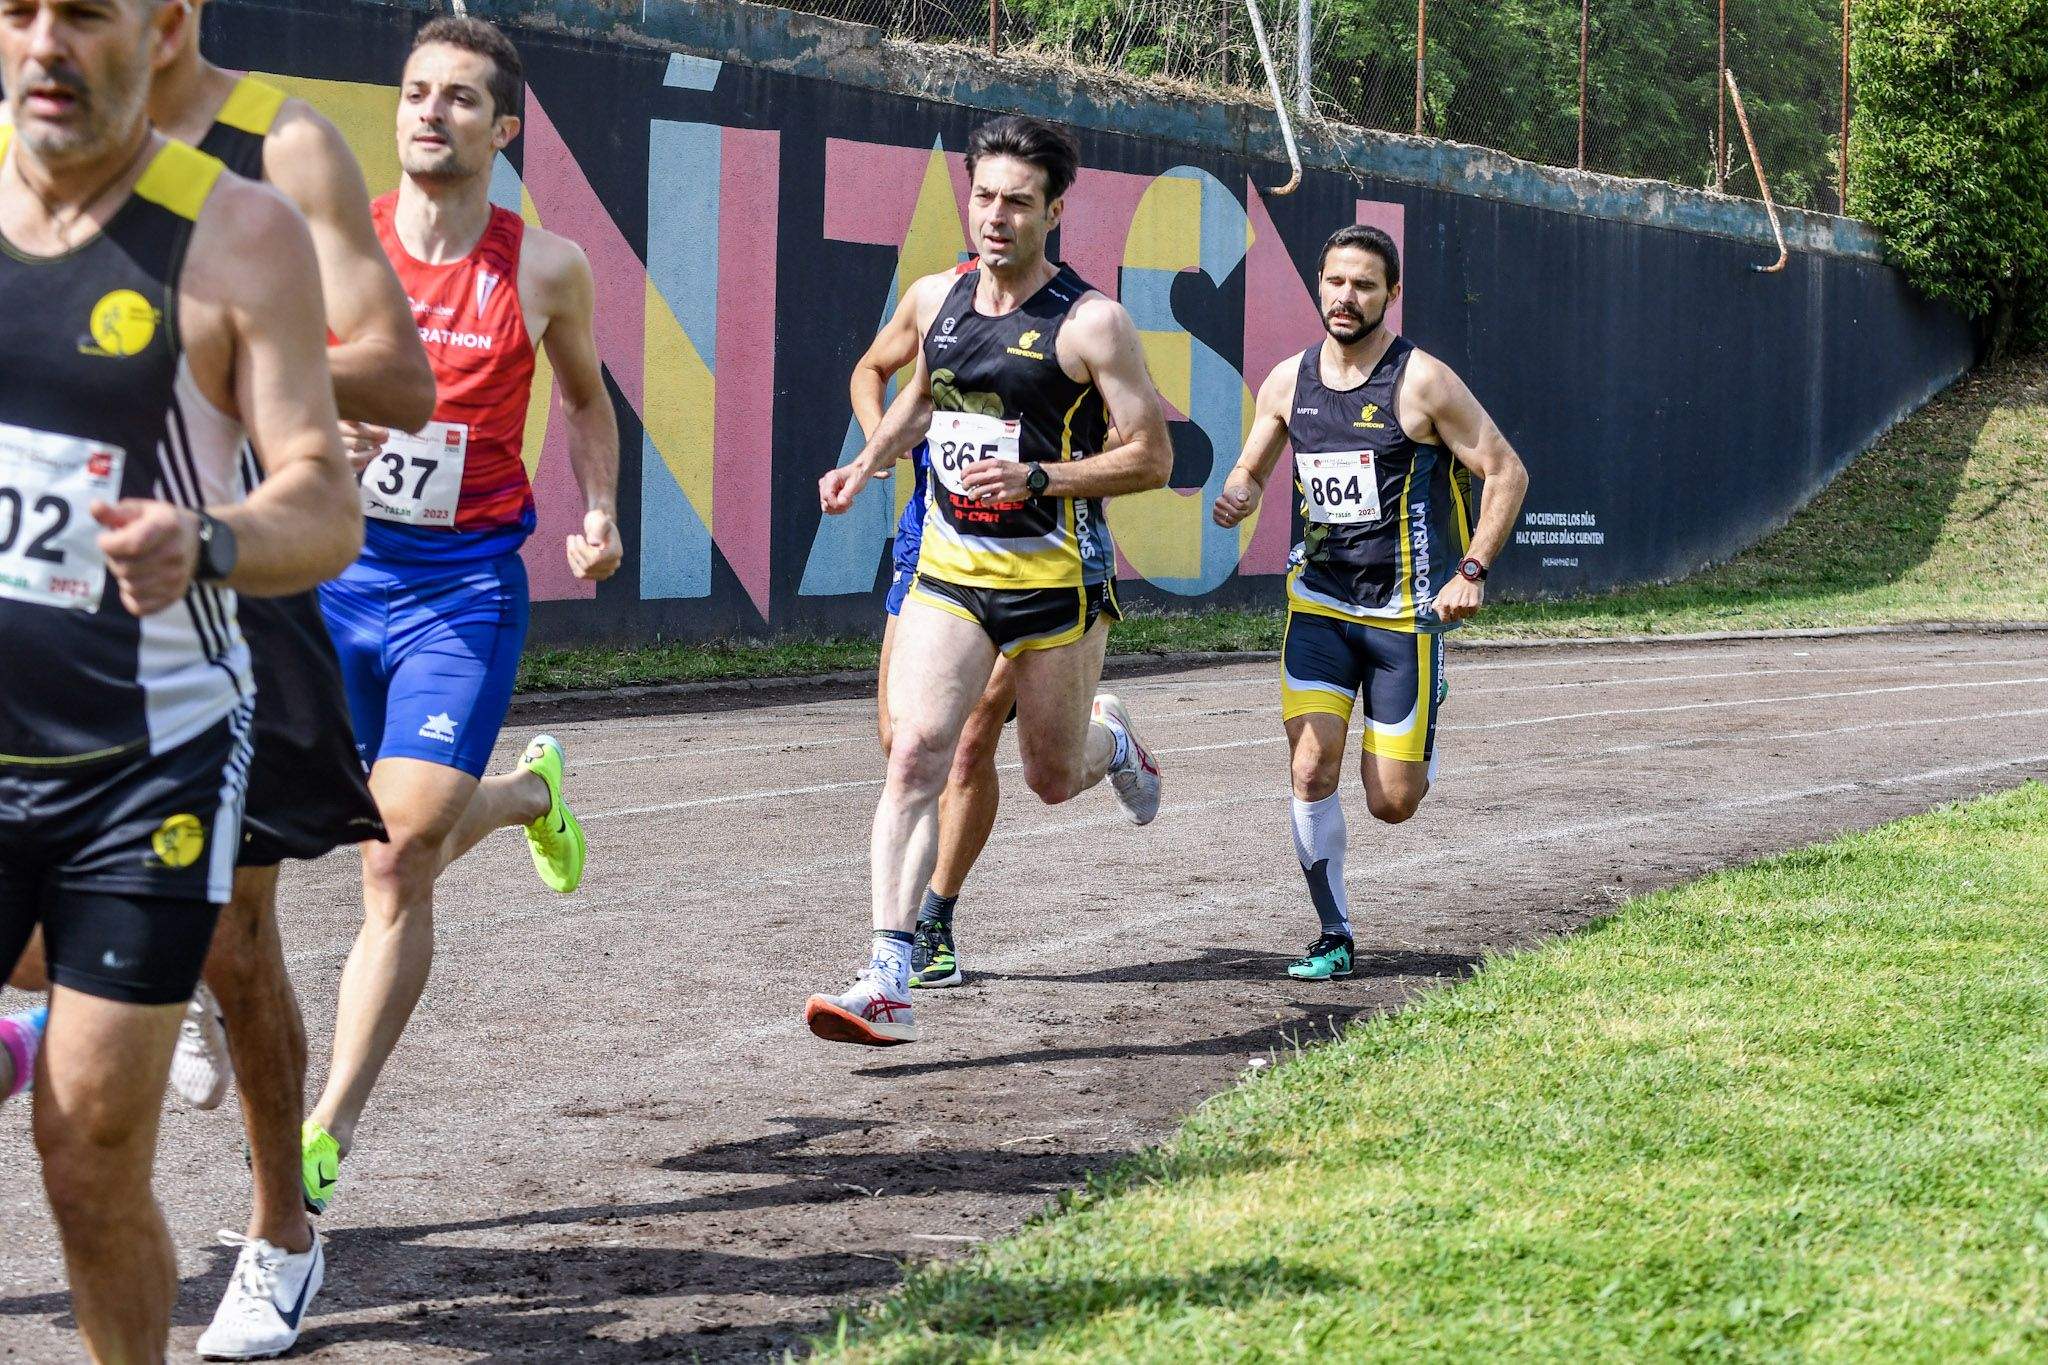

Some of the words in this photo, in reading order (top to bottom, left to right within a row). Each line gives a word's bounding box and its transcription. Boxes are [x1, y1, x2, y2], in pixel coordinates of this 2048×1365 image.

[378, 453, 438, 500] 37
[1311, 476, 1362, 506] 864
[423, 508, 448, 519] 2023
[1358, 508, 1376, 516] 2023
[1526, 513, 1536, 525] NO
[1537, 513, 1566, 526] CUENTES
[1568, 513, 1580, 526] LOS
[1581, 510, 1596, 526] DÍAS
[1516, 531, 1529, 544] HAZ
[1530, 531, 1545, 546] QUE
[1546, 531, 1559, 544] LOS
[1560, 528, 1575, 544] DÍAS
[1575, 532, 1605, 544] CUENTEN
[1411, 502, 1433, 616] MYRMIDONS
